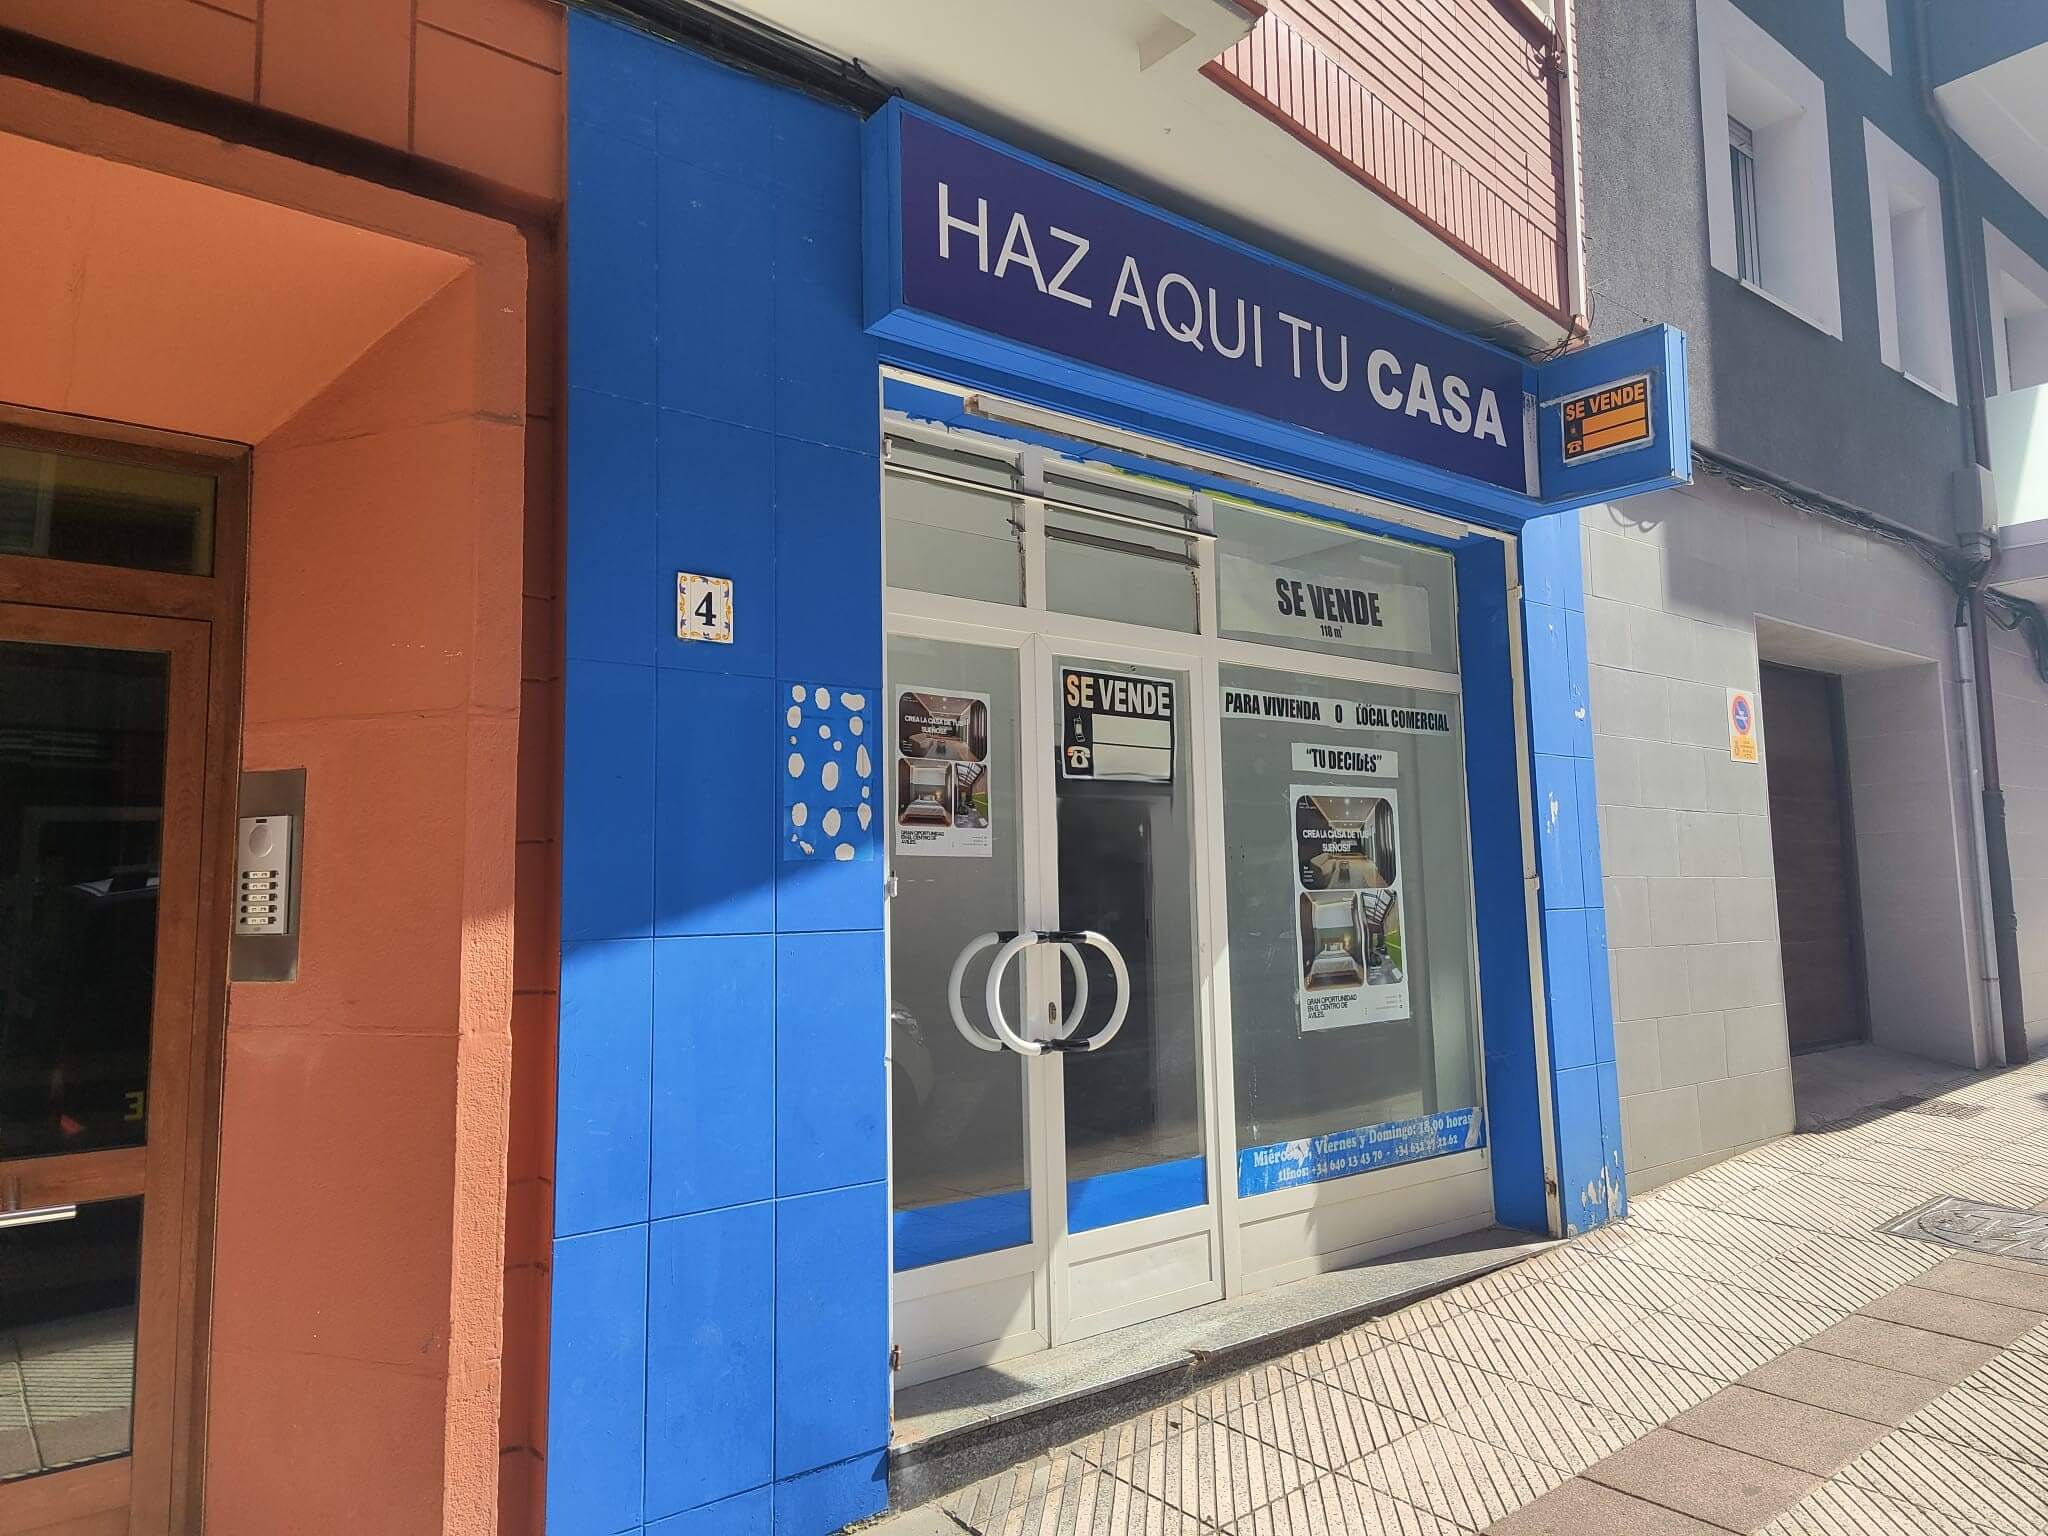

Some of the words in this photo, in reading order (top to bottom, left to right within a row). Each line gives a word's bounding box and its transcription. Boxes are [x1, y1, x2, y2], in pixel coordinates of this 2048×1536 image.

[938, 181, 1092, 309] HAZ
[1108, 255, 1263, 368] AQUI
[1278, 310, 1349, 393] TU
[1367, 348, 1509, 447] CASA
[1565, 400, 1586, 421] SE
[1589, 382, 1646, 414] VENDE
[694, 591, 717, 627] 4
[1275, 577, 1306, 618] SE
[1306, 583, 1383, 628] VENDE
[1065, 673, 1095, 710] SE
[1097, 679, 1172, 717] VENDE
[1225, 692, 1261, 715] PARA
[1262, 695, 1321, 721] VIVIENDA
[1355, 705, 1389, 728] LOCAL
[1391, 709, 1450, 732] COMERCIAL
[1302, 829, 1320, 839] CREA
[1320, 829, 1327, 839] LA
[1327, 829, 1347, 839] CASA
[1347, 830, 1356, 839] DE
[1306, 997, 1321, 1006] GRAN
[1321, 993, 1358, 1004] OPORTUNIDAD
[1320, 1002, 1341, 1011] CENTRO
[1341, 1001, 1349, 1009] DE
[1314, 1136, 1357, 1155] Viernes
[1357, 1135, 1365, 1149] y
[1369, 1125, 1417, 1144] Domingo:
[1360, 1152, 1371, 1165] 43
[1372, 1149, 1383, 1162] 70
